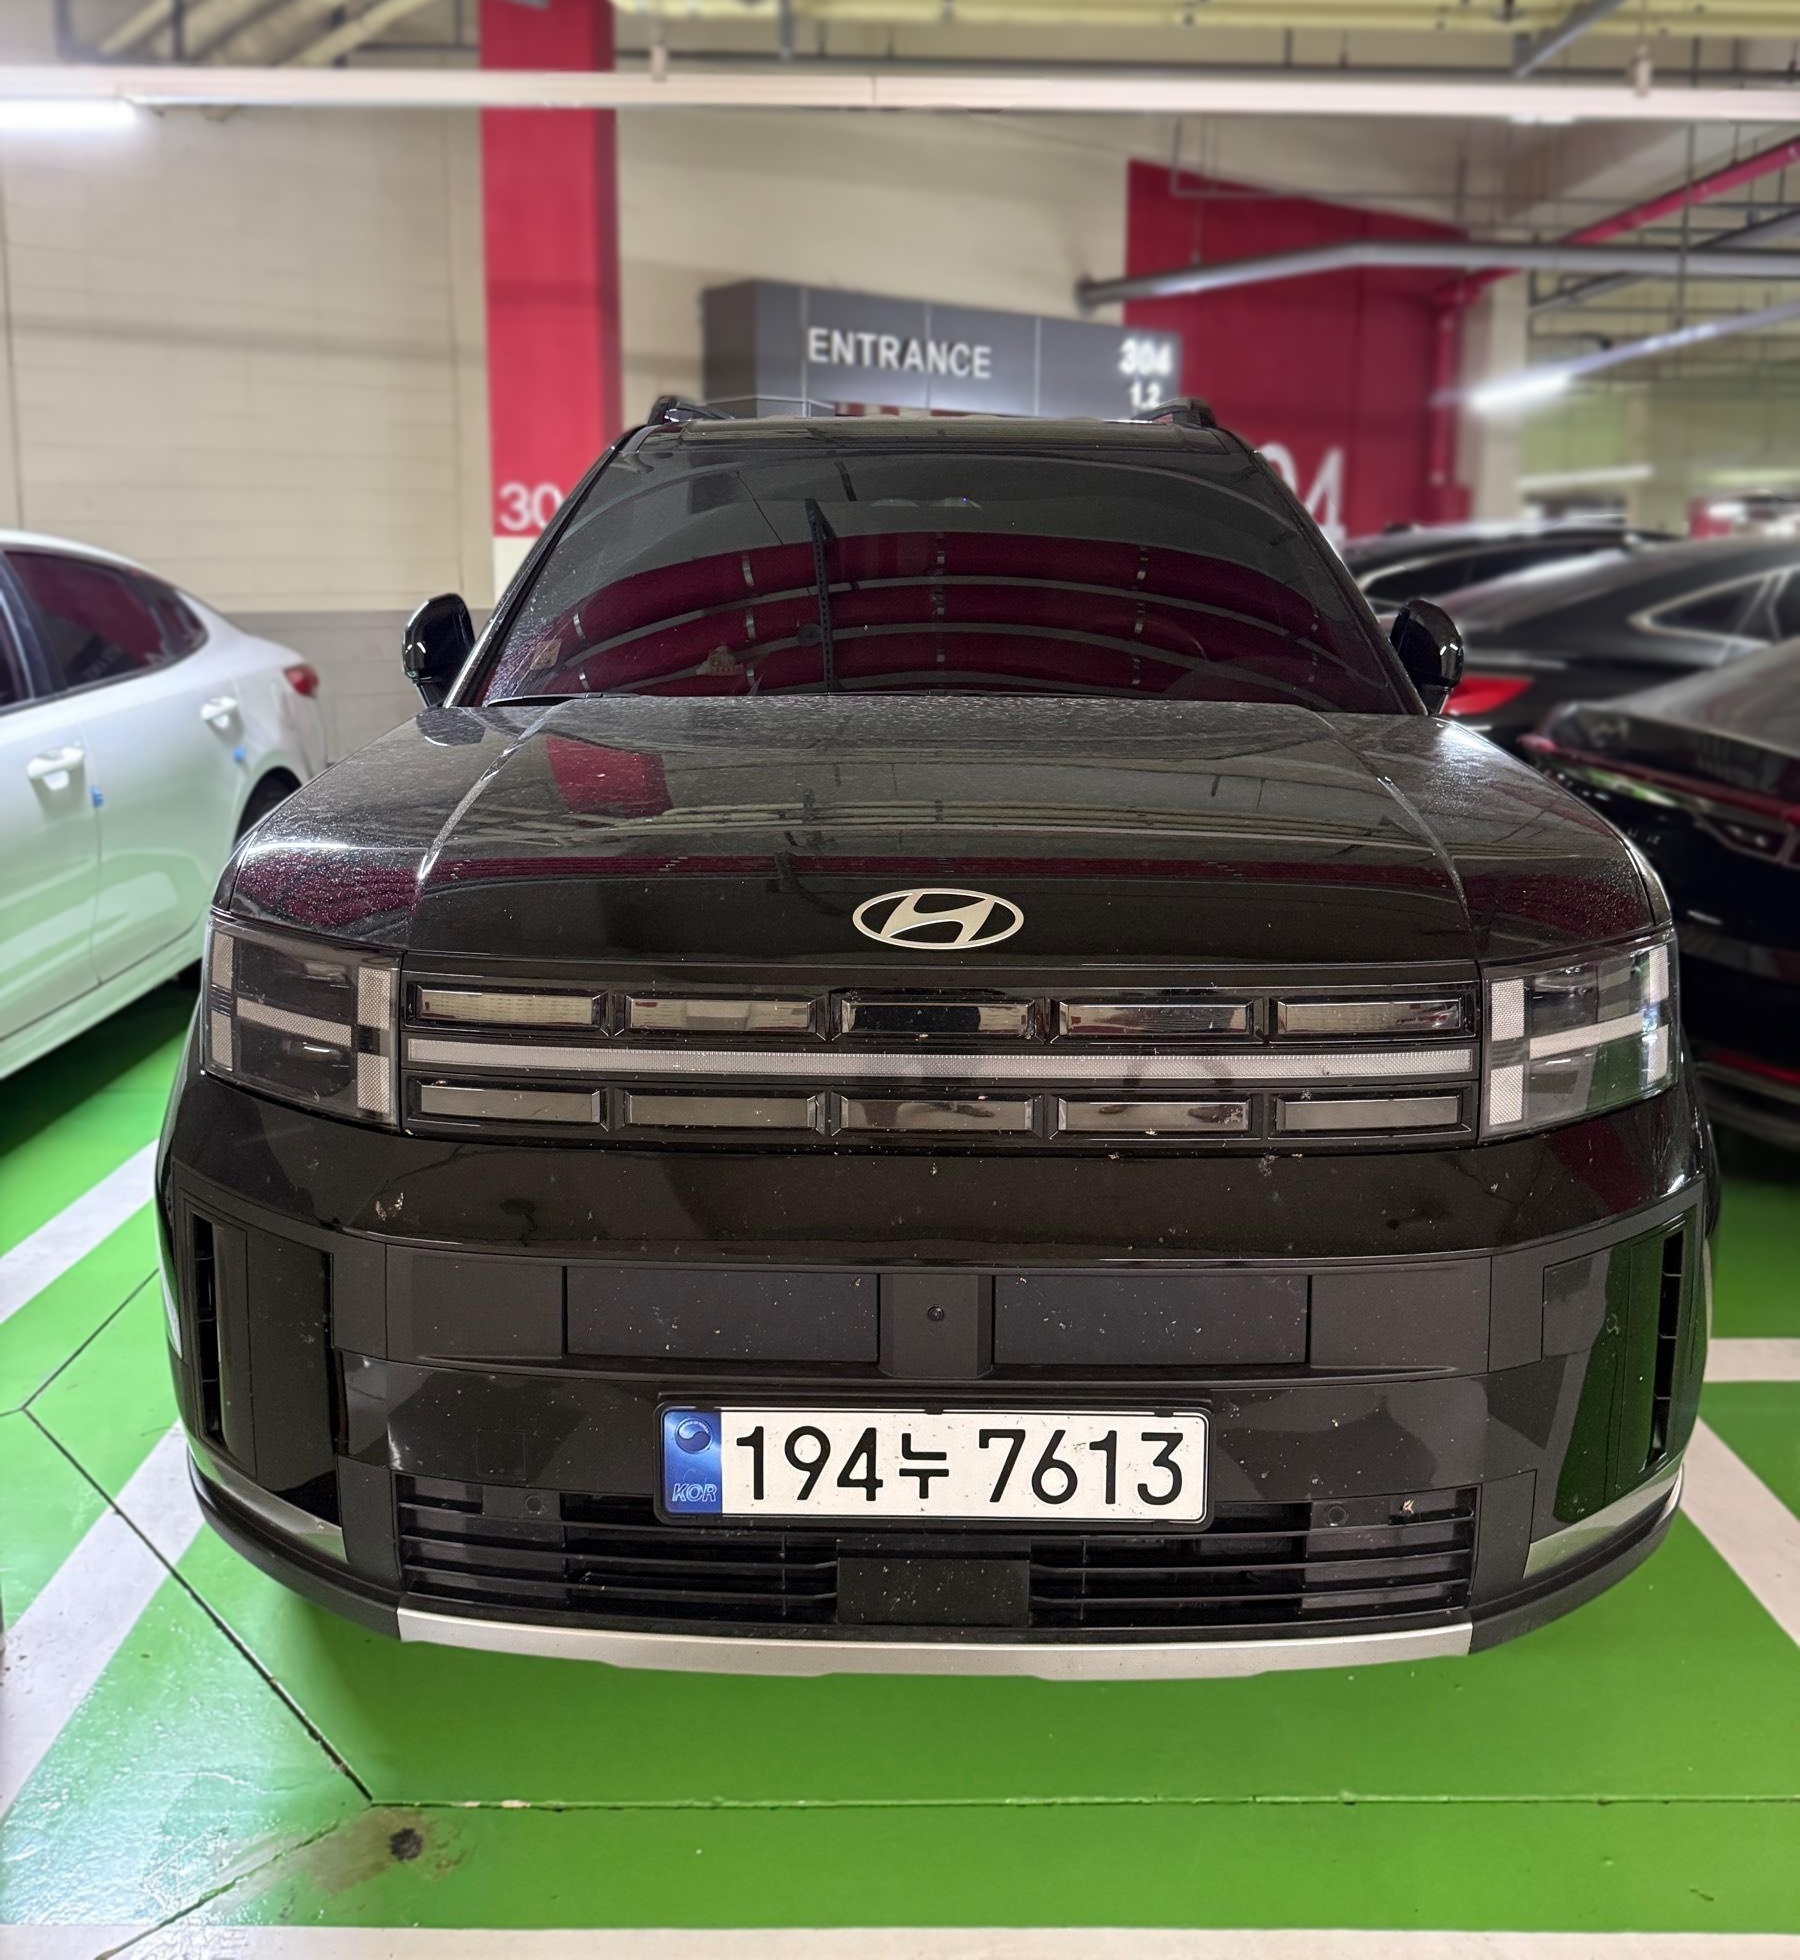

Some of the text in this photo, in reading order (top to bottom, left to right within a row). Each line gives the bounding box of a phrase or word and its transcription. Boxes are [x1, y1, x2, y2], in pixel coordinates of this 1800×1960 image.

[807, 327, 992, 379] ENTRANCE
[1119, 337, 1173, 376] 304
[735, 1425, 1184, 1506] 194누 7613
[671, 1482, 718, 1502] KOR
